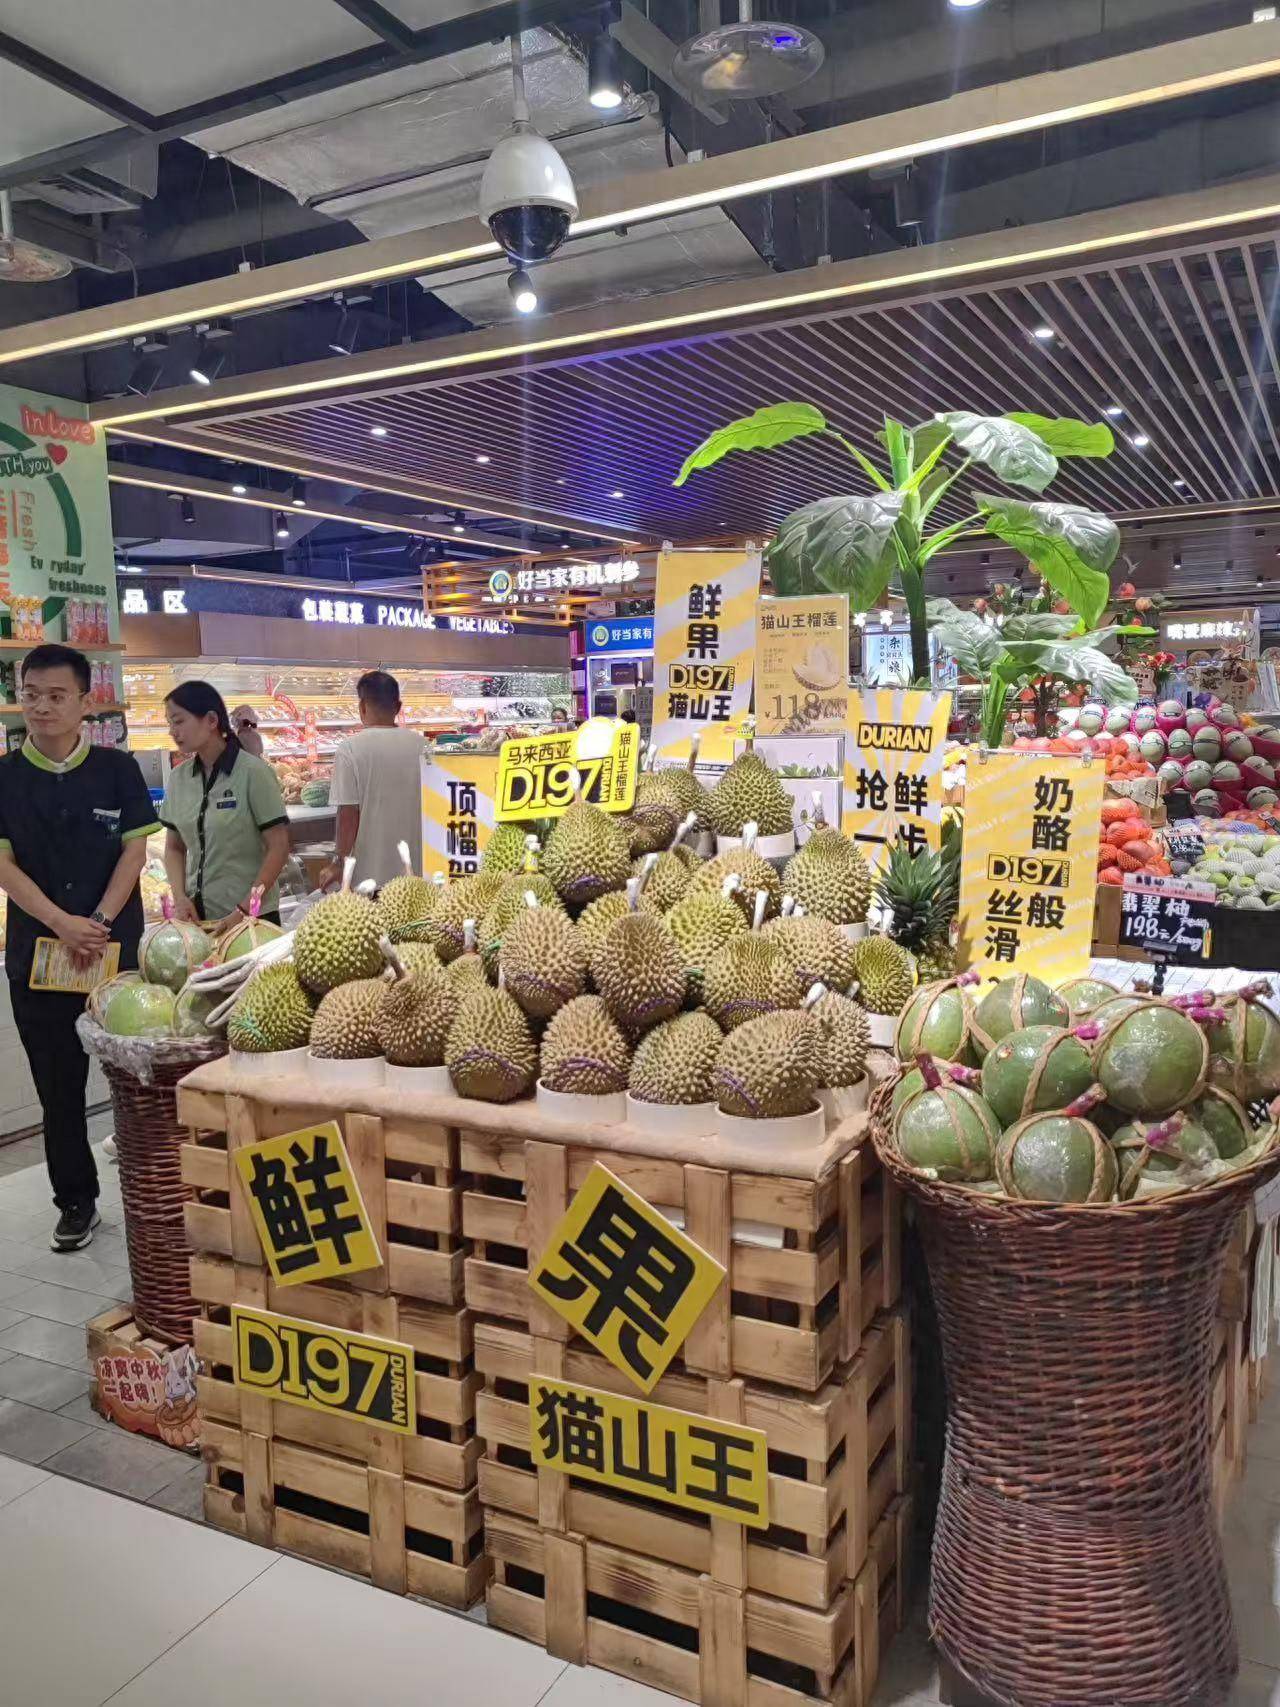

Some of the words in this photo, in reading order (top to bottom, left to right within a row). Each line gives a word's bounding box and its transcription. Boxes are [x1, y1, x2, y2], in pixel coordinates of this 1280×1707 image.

[0, 455, 24, 473] TH
[48, 577, 107, 596] freshness
[760, 611, 838, 630] 猫山王榴莲
[668, 692, 732, 721] 猫山王
[506, 739, 572, 765] 马来西亚
[858, 723, 932, 752] DURIAN
[614, 732, 632, 801] 猫山王榴莲
[856, 768, 929, 816] 抢鲜
[249, 1135, 363, 1275] 鲜
[537, 1184, 696, 1381] 果
[237, 1316, 390, 1414] D197
[390, 1354, 407, 1426] DURIAN
[536, 1385, 760, 1515] 猫山王
